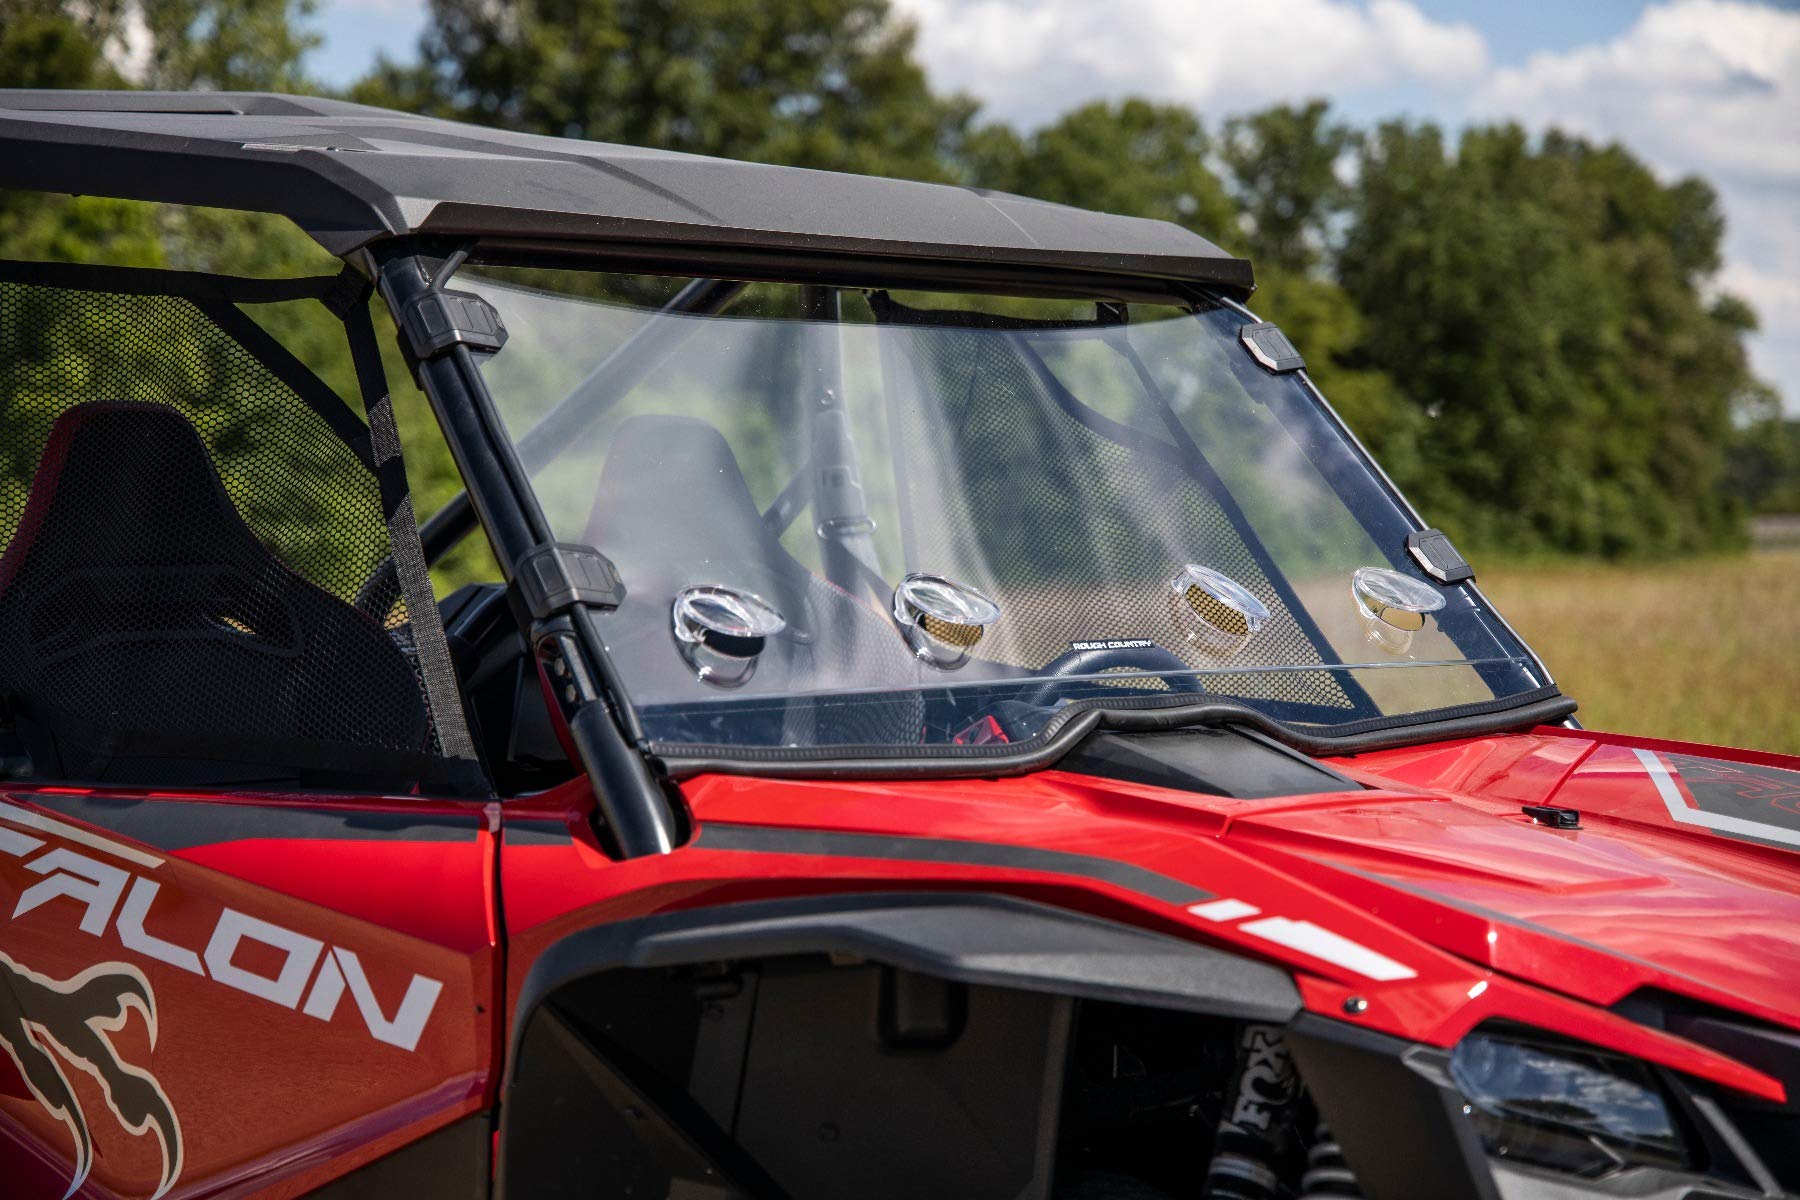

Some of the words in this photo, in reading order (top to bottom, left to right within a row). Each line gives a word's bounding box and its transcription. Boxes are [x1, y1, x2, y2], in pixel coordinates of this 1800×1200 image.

[1072, 642, 1107, 650] ROUGH
[1107, 640, 1152, 649] COUNTRY
[1231, 1025, 1297, 1131] FOX
